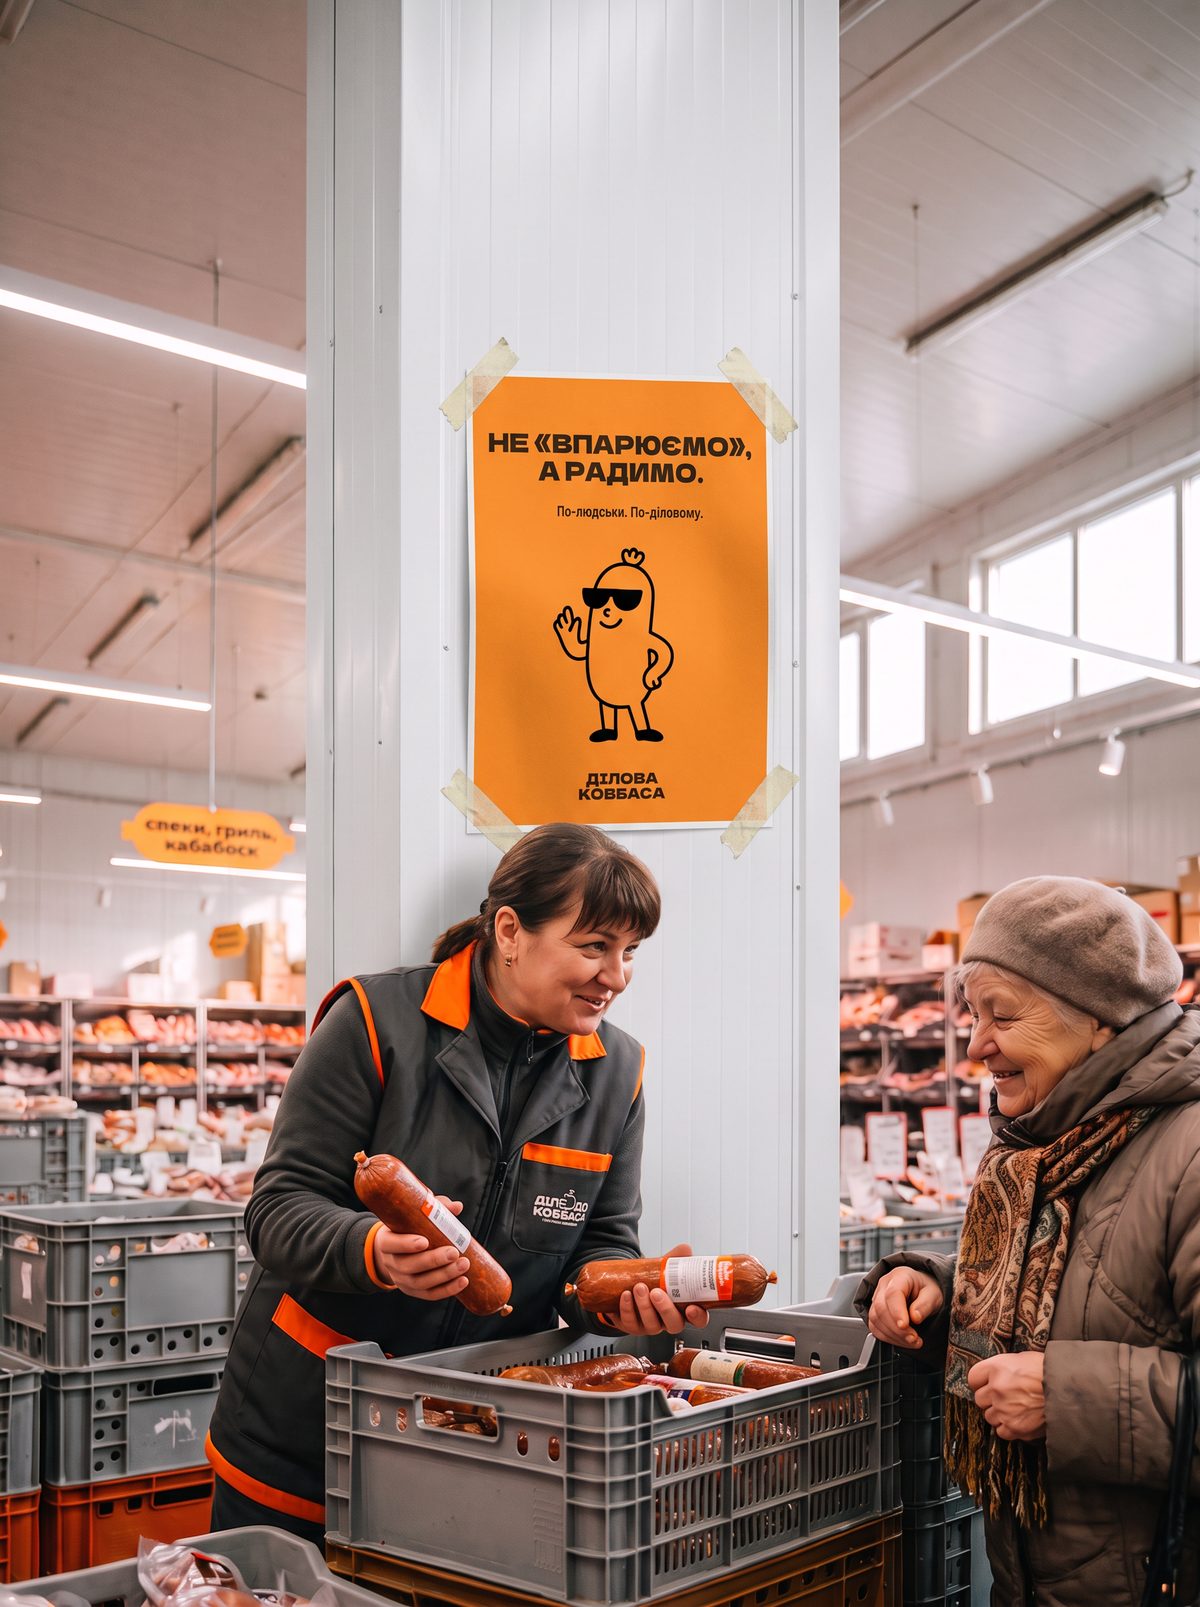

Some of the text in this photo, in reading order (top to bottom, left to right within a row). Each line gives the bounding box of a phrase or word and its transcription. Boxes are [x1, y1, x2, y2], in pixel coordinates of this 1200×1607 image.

[488, 433, 752, 461] НЕ «ВПАРЮЄМО»,
[538, 461, 704, 486] А РАДИМО.
[557, 505, 704, 521] По-людськи. По-діловому.
[586, 772, 658, 788] ДІЛОВА
[578, 787, 665, 801] КОВБАСА
